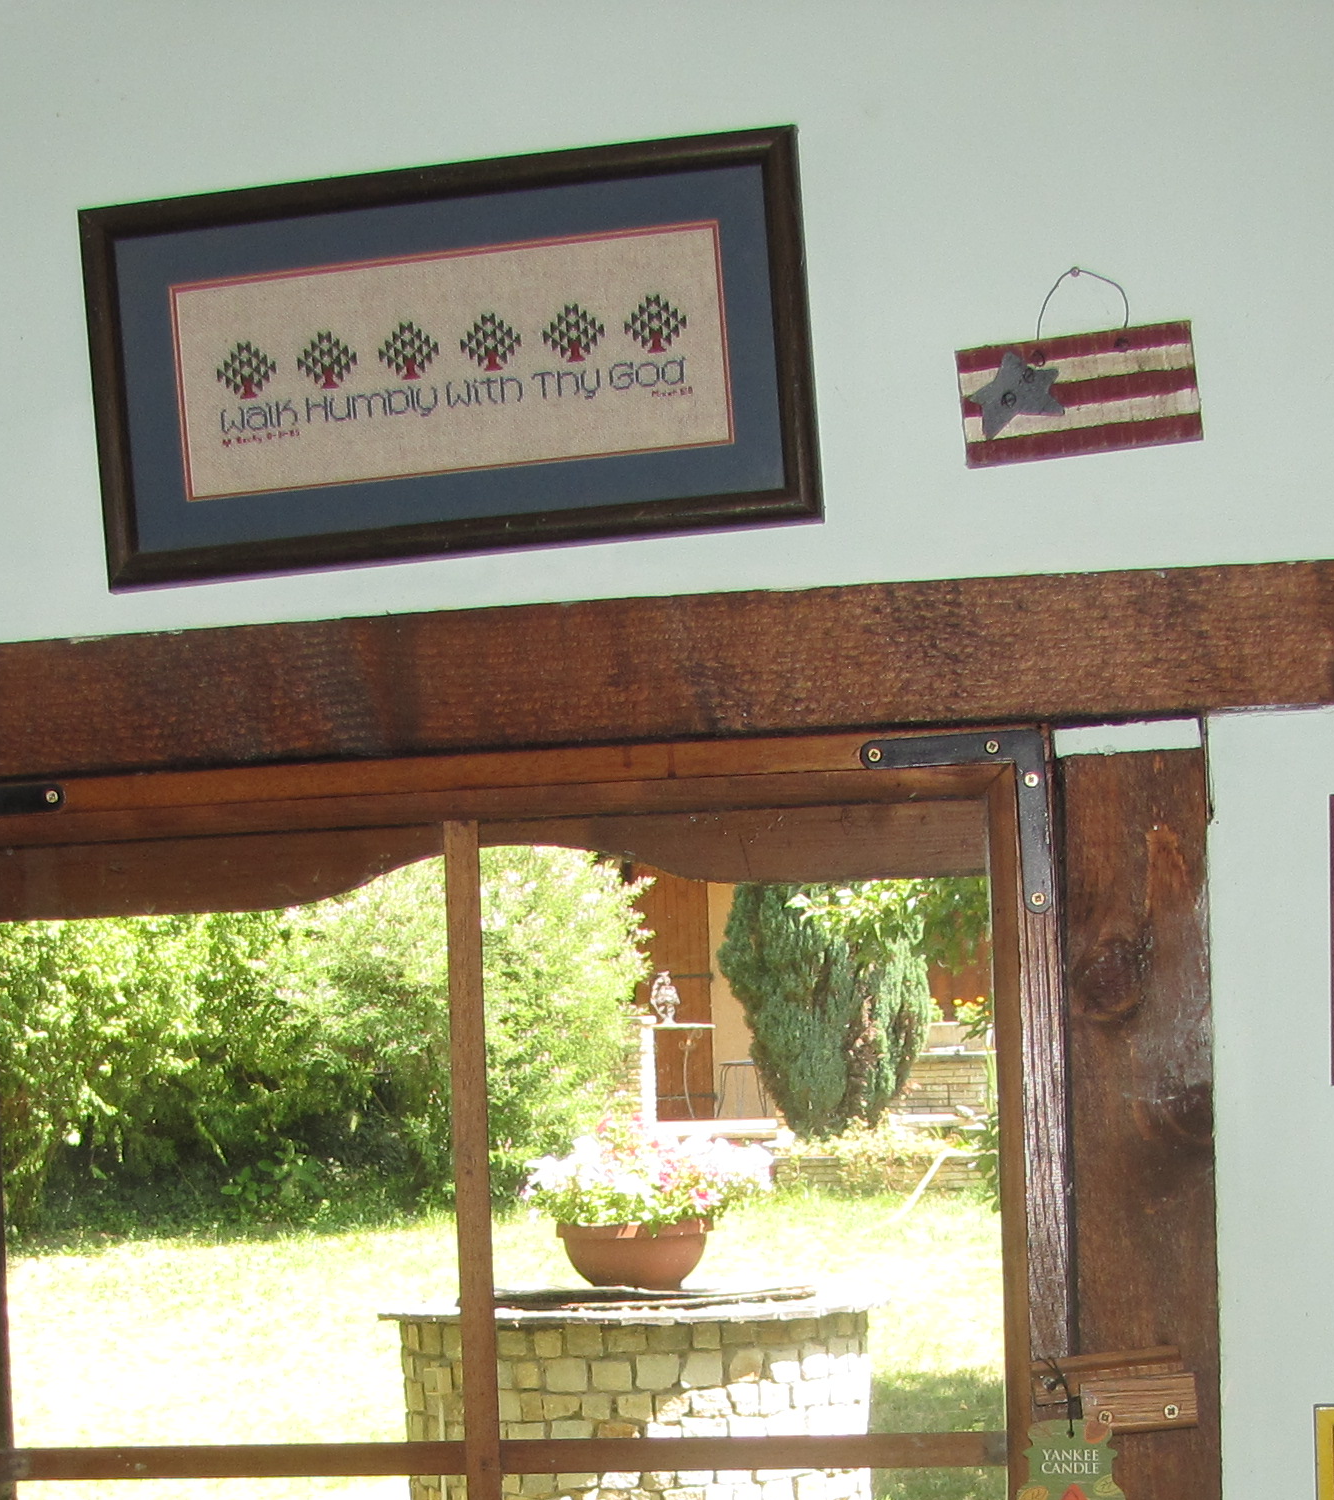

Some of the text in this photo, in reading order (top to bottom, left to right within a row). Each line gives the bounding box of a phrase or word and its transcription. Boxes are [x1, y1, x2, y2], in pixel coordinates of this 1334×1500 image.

[220, 356, 687, 434] Walk Humbly With Thy God
[1041, 1449, 1100, 1462] YANKEE
[1040, 1462, 1100, 1475] CANDLE
